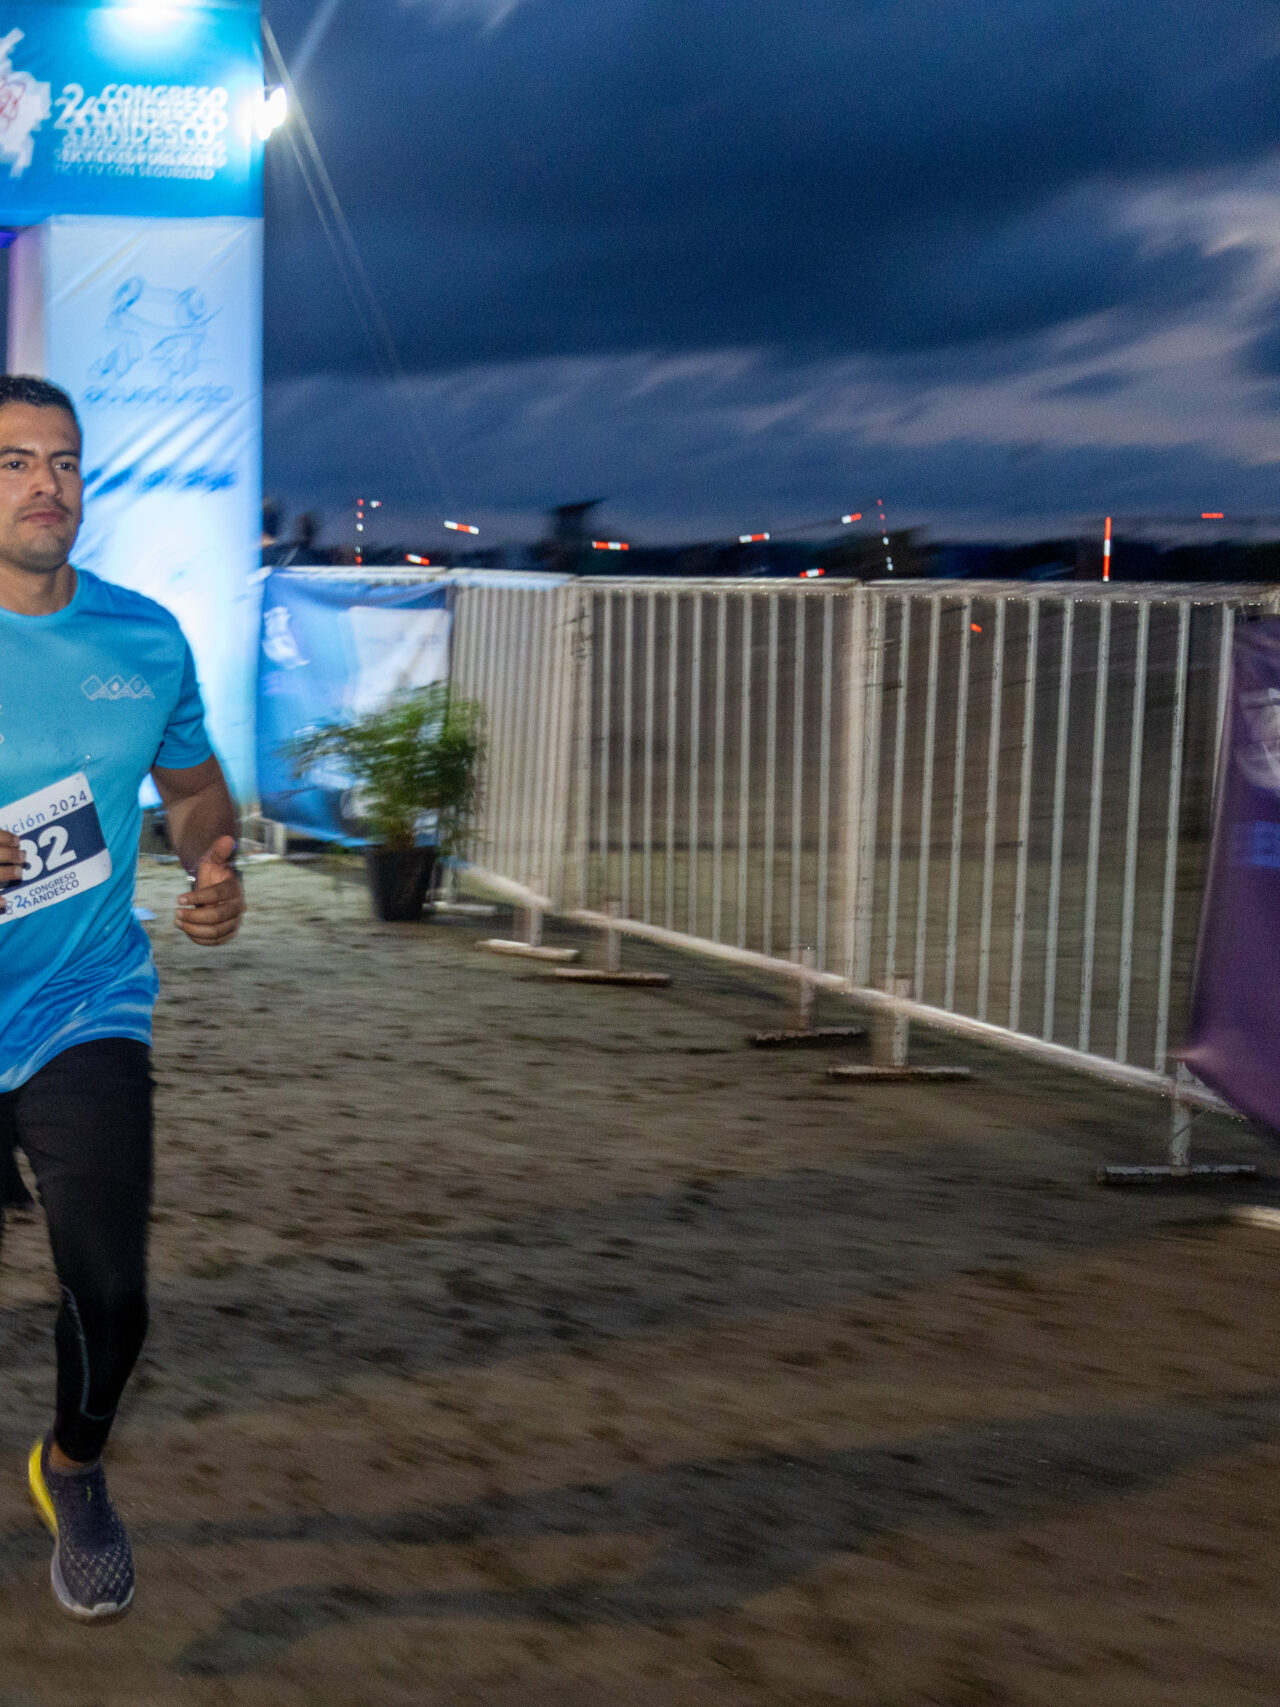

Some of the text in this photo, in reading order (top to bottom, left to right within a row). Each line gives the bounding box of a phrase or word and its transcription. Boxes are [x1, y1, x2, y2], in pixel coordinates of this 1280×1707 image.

[49, 790, 88, 817] 2024
[29, 871, 78, 897] CONGRESO
[31, 879, 80, 906] ANDESCO
